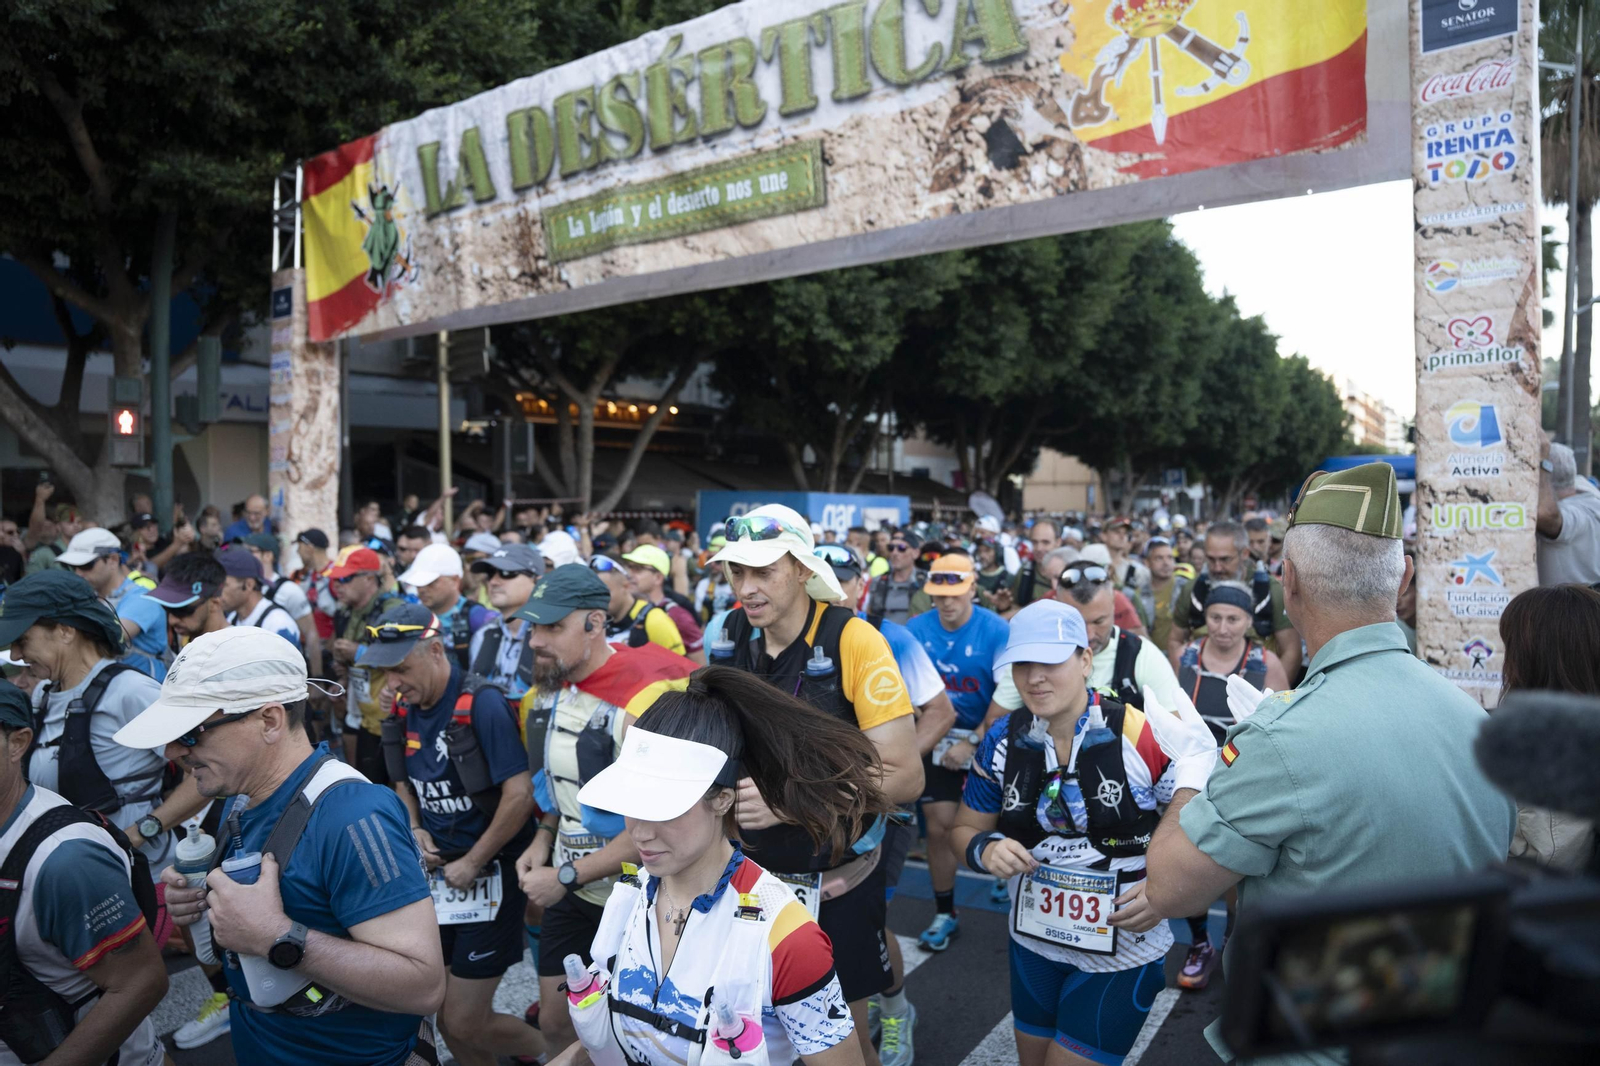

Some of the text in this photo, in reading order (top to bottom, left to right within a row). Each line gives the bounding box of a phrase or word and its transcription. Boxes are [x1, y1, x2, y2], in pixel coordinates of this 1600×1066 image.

[1441, 7, 1496, 28] SENATOR
[417, 0, 1029, 218] LA DESÉRTICA
[1427, 113, 1511, 137] GRUPO
[1427, 128, 1515, 159] RENTA
[1427, 151, 1515, 182] TODO
[567, 171, 788, 238] La Legión y el desierto nos une
[1429, 348, 1521, 371] primaflor
[1447, 452, 1504, 465] Almería
[1452, 466, 1500, 476] Activa
[1447, 591, 1509, 602] Fundación
[1101, 831, 1151, 847] Columbus
[1039, 887, 1101, 924] 3193
[107, 911, 123, 924] UNE
[450, 911, 473, 921] asisa
[1045, 927, 1072, 942] asisa
[1073, 924, 1096, 933] SANDRA
